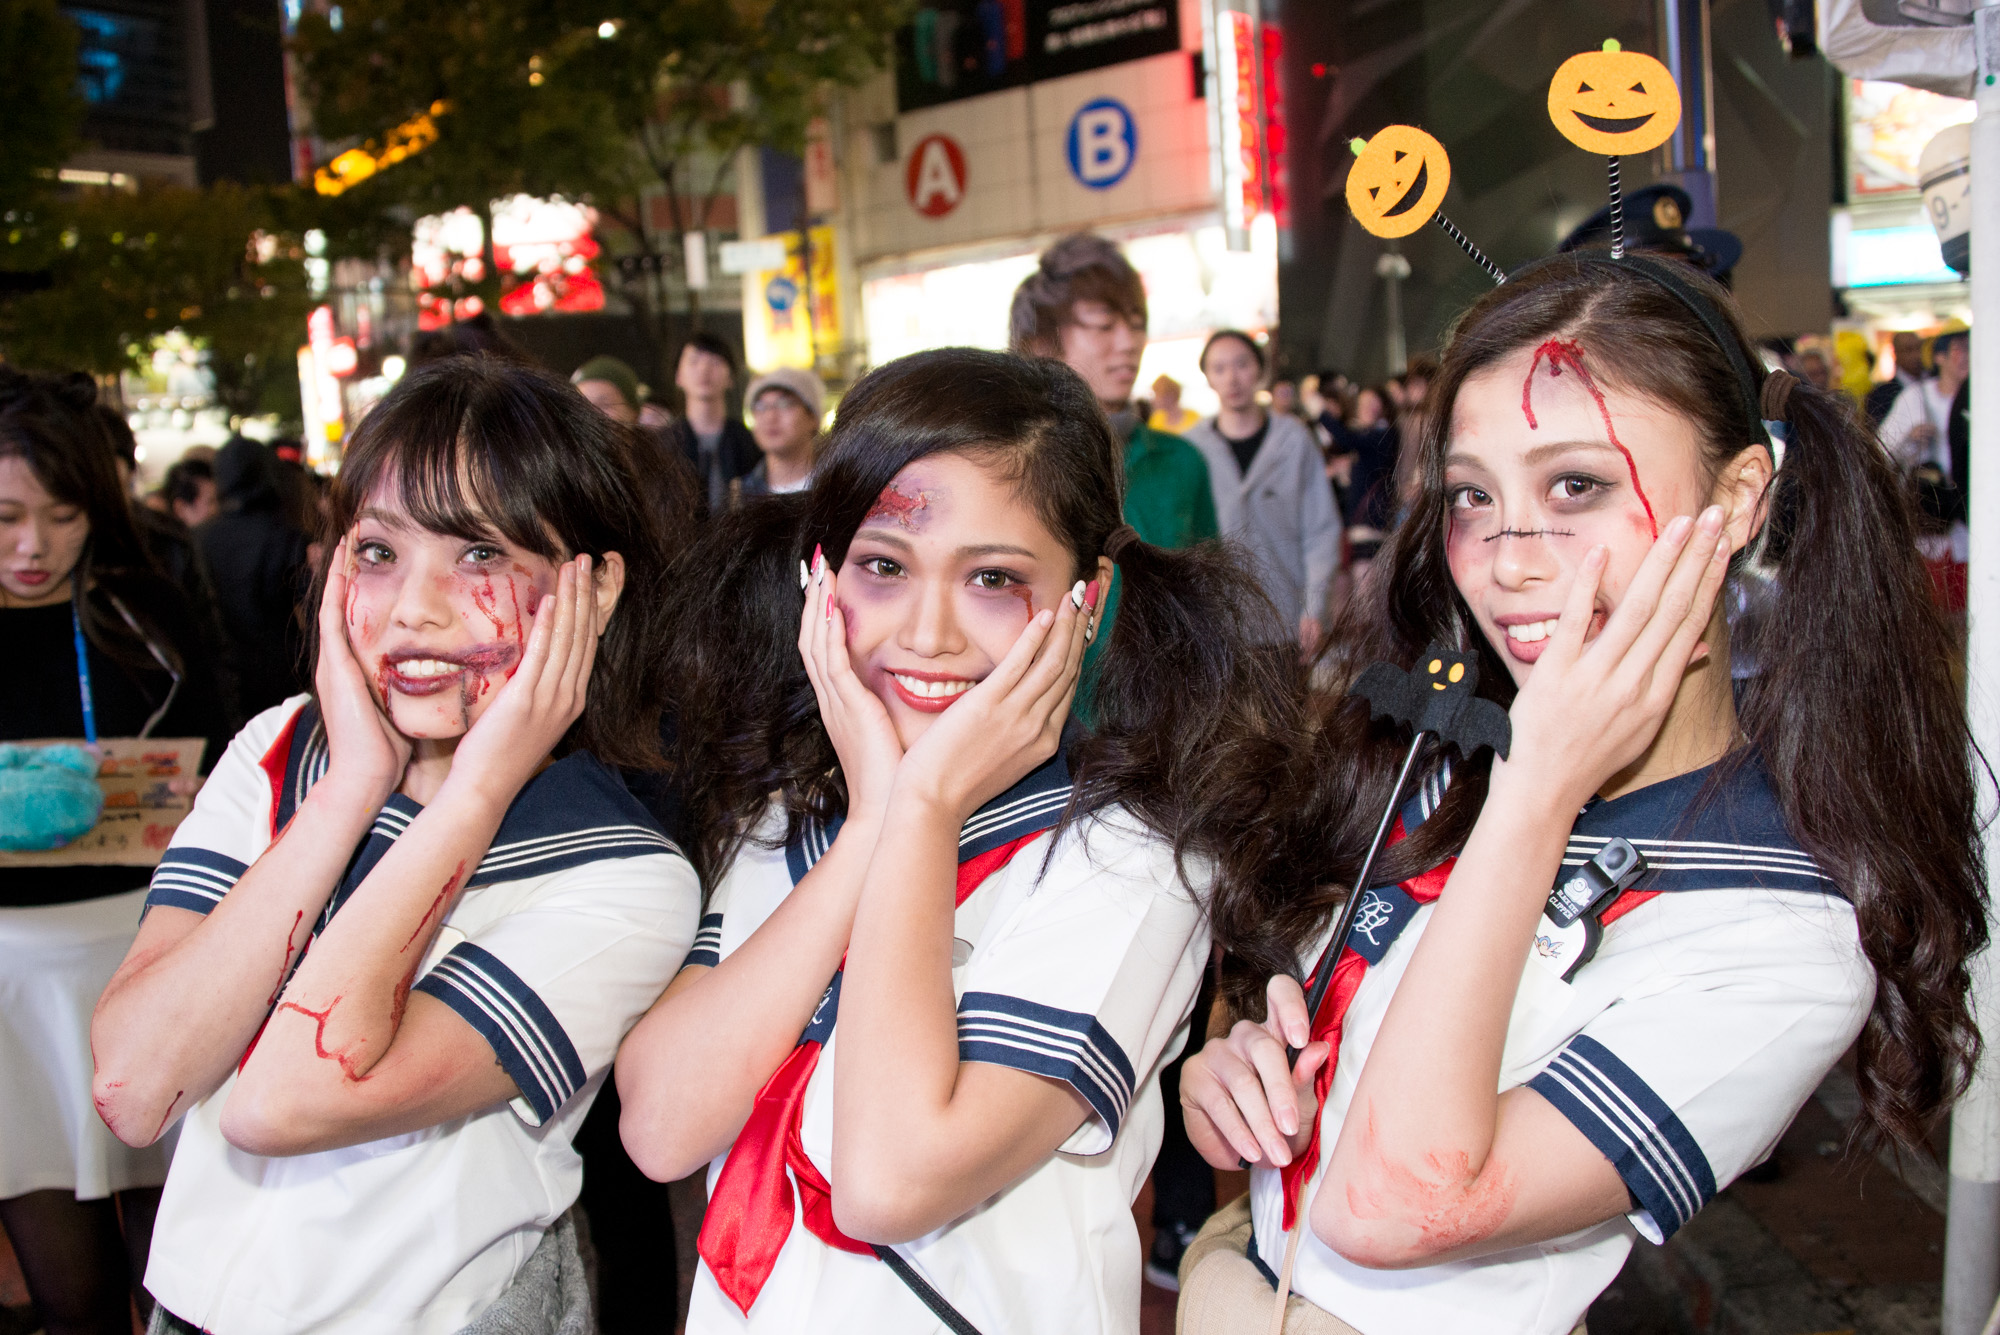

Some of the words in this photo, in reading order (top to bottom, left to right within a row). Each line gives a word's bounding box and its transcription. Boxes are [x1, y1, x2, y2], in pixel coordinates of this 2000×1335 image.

[1078, 107, 1130, 182] B
[912, 139, 960, 207] A
[1549, 896, 1574, 920] CLIPPER
[1556, 889, 1571, 905] BLACK
[1568, 903, 1579, 915] EYE
